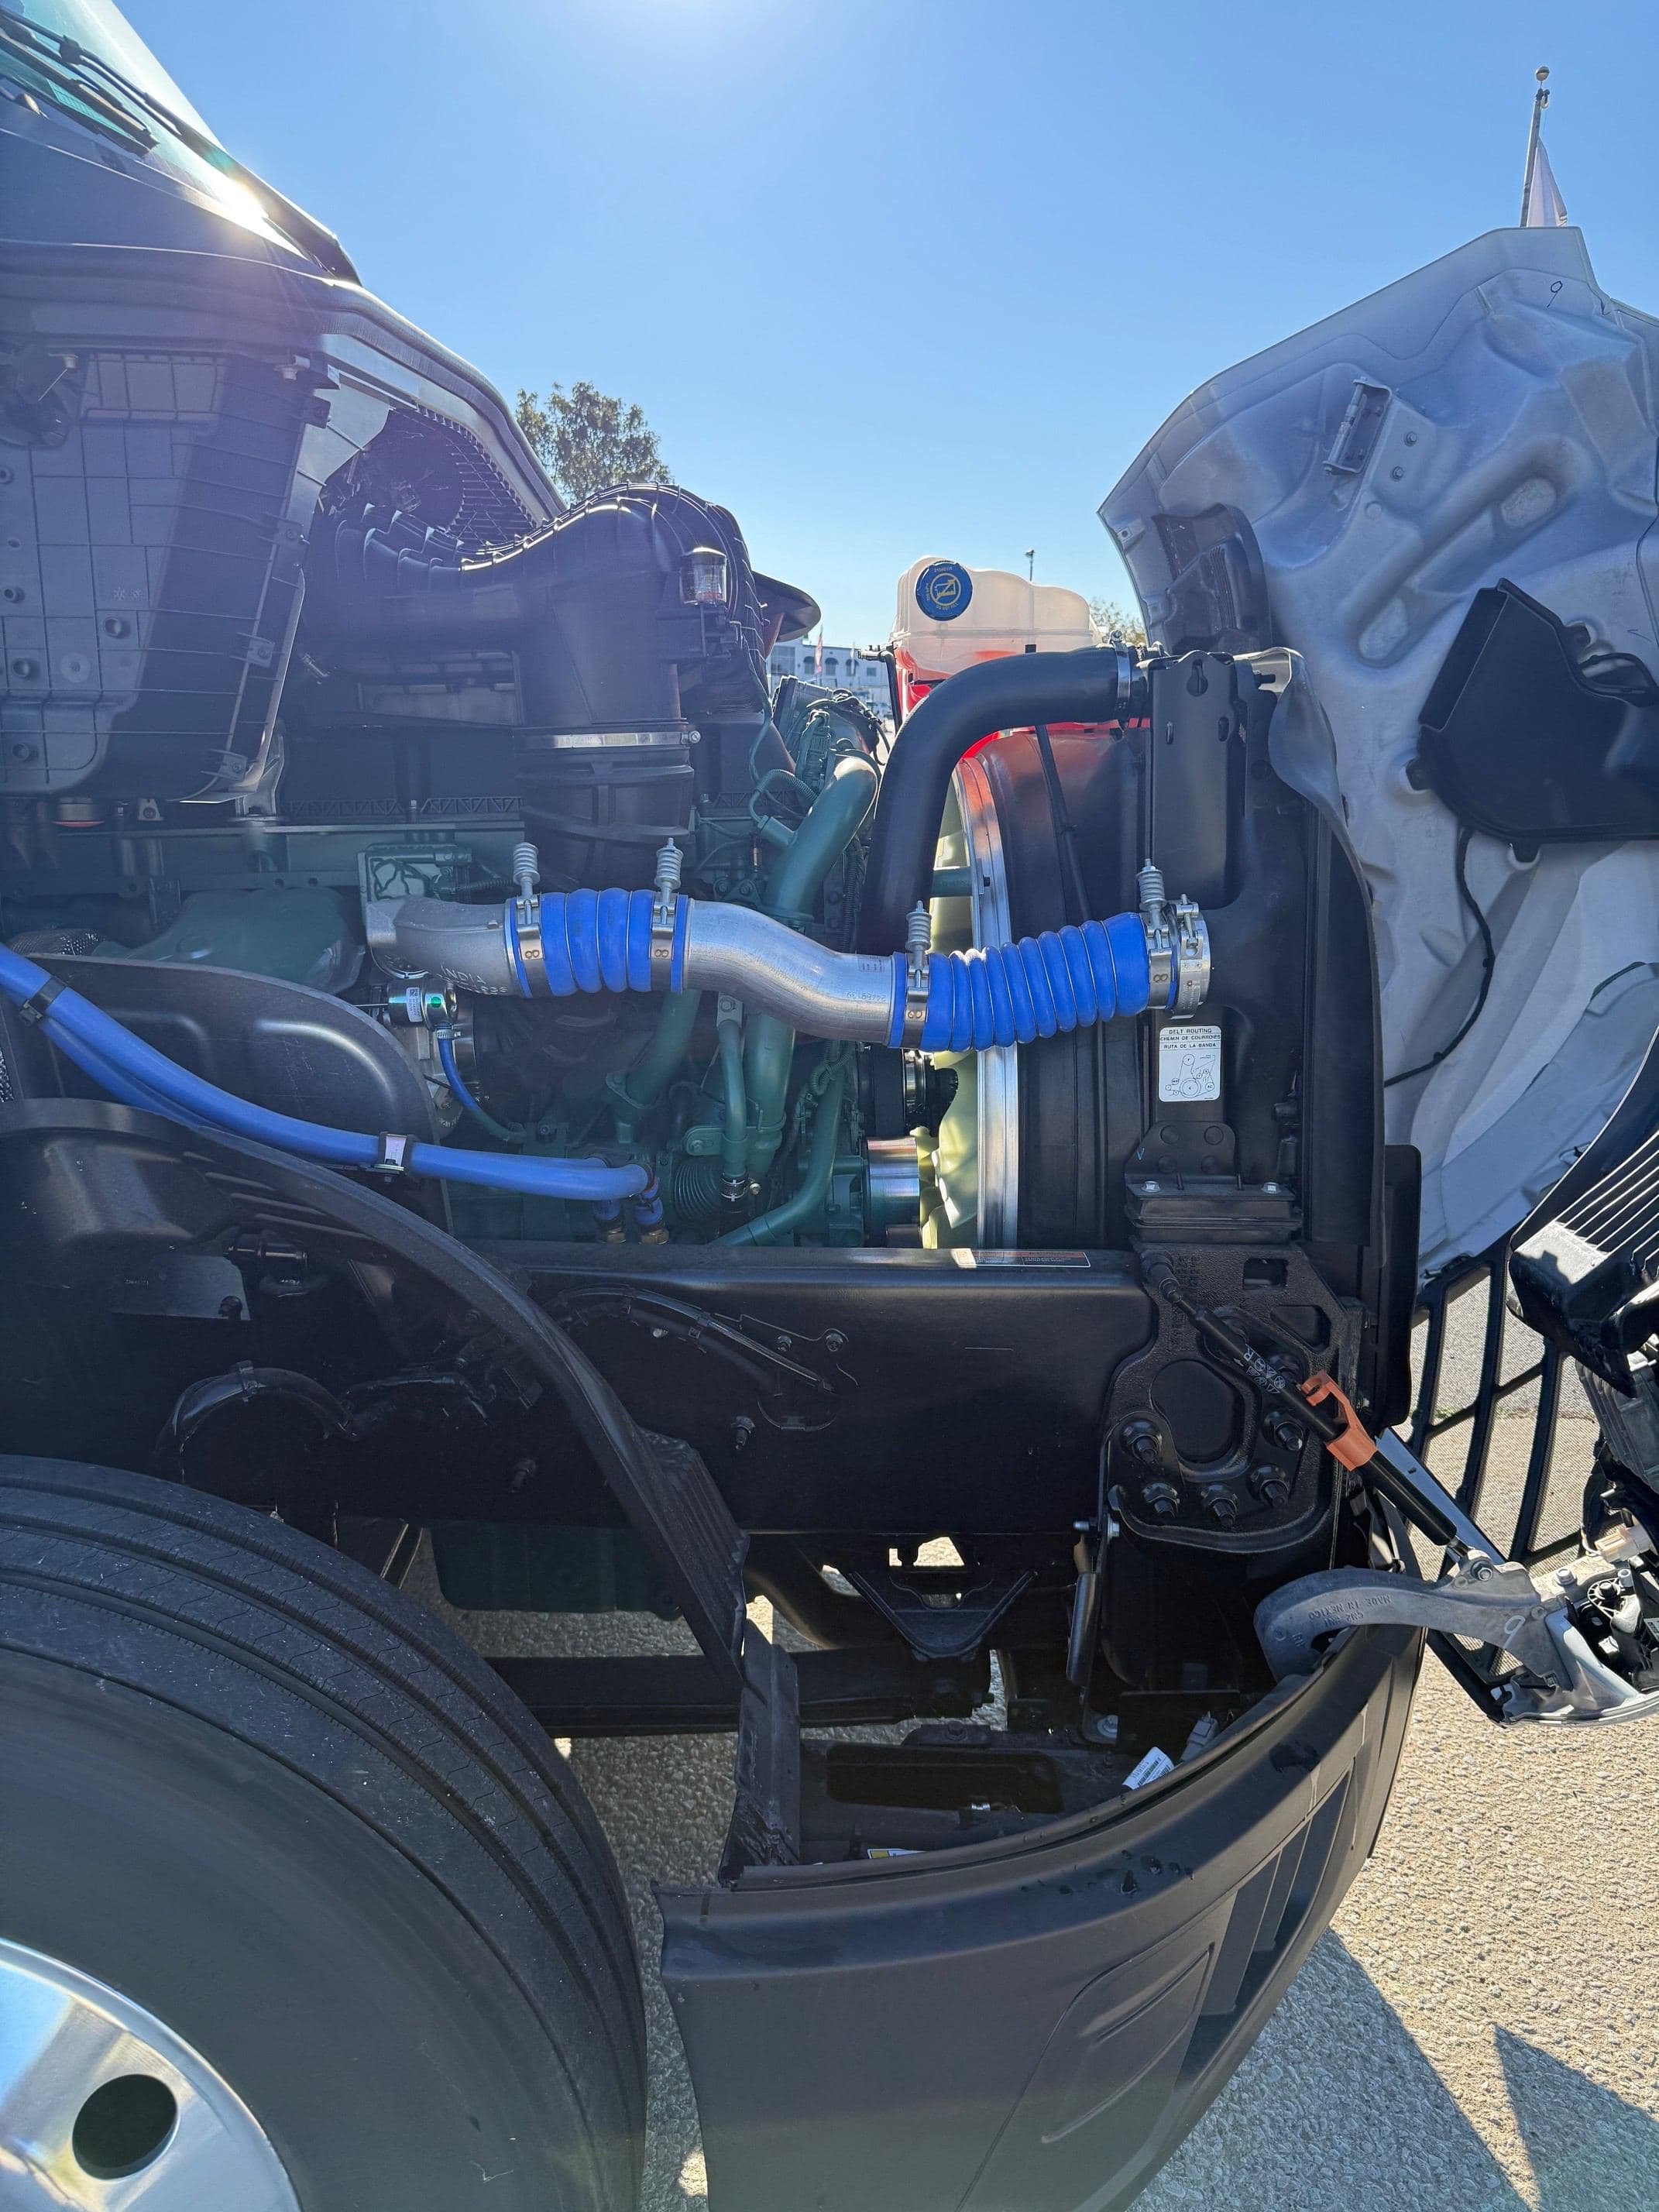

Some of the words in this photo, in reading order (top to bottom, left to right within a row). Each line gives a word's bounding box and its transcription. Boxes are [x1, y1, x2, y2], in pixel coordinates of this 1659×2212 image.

[1348, 1600, 1360, 1611] IN
[1365, 1594, 1392, 1607] MADE
[1307, 1603, 1345, 1620] MEXICO
